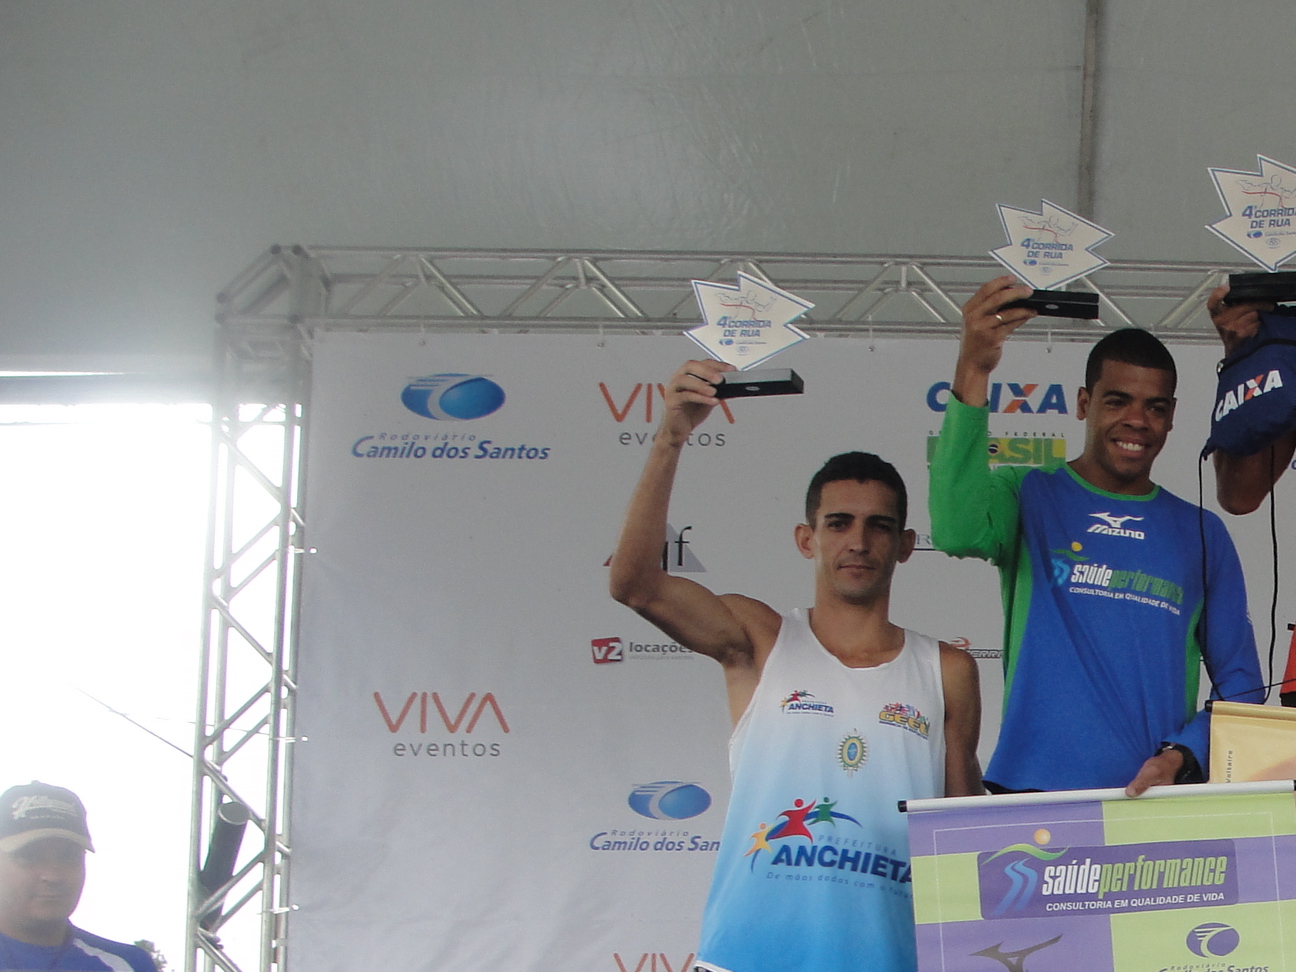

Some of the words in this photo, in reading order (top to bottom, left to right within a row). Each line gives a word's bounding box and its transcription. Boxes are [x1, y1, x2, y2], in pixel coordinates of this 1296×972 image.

[1250, 219, 1265, 229] DE
[1268, 218, 1291, 228] RUA
[1031, 242, 1073, 251] CORRIDA
[1043, 251, 1063, 259] RUA
[723, 329, 738, 337] DE
[740, 329, 760, 337] RUA
[926, 381, 1068, 414] CIXA
[1215, 369, 1283, 422] CAIXA
[379, 432, 476, 441] Rodoviário
[619, 431, 726, 447] evtos
[351, 435, 427, 459] Camilo
[432, 443, 471, 459] dos
[475, 439, 550, 460] Santos
[1087, 523, 1145, 540] MIZUNO
[1069, 586, 1114, 599] CONSULTORIA
[1125, 593, 1160, 608] QUALIDADE
[1160, 602, 1169, 610] DE
[1169, 606, 1181, 616] VIDA
[374, 691, 510, 734] VIVA
[788, 703, 834, 713] ANCHIETA
[393, 739, 501, 757] eventos
[589, 832, 650, 851] Camilo
[654, 837, 685, 851] dos
[687, 835, 720, 851] San
[818, 834, 897, 856] PREFEITURA
[785, 871, 813, 881] mãos
[817, 875, 849, 885] dadas
[854, 881, 875, 889] com
[1046, 901, 1112, 911] CONSULTORIA
[1114, 899, 1129, 908] EM
[1131, 895, 1185, 907] QUALIDADE
[1187, 893, 1200, 902] DE
[1203, 892, 1225, 901] VIDA
